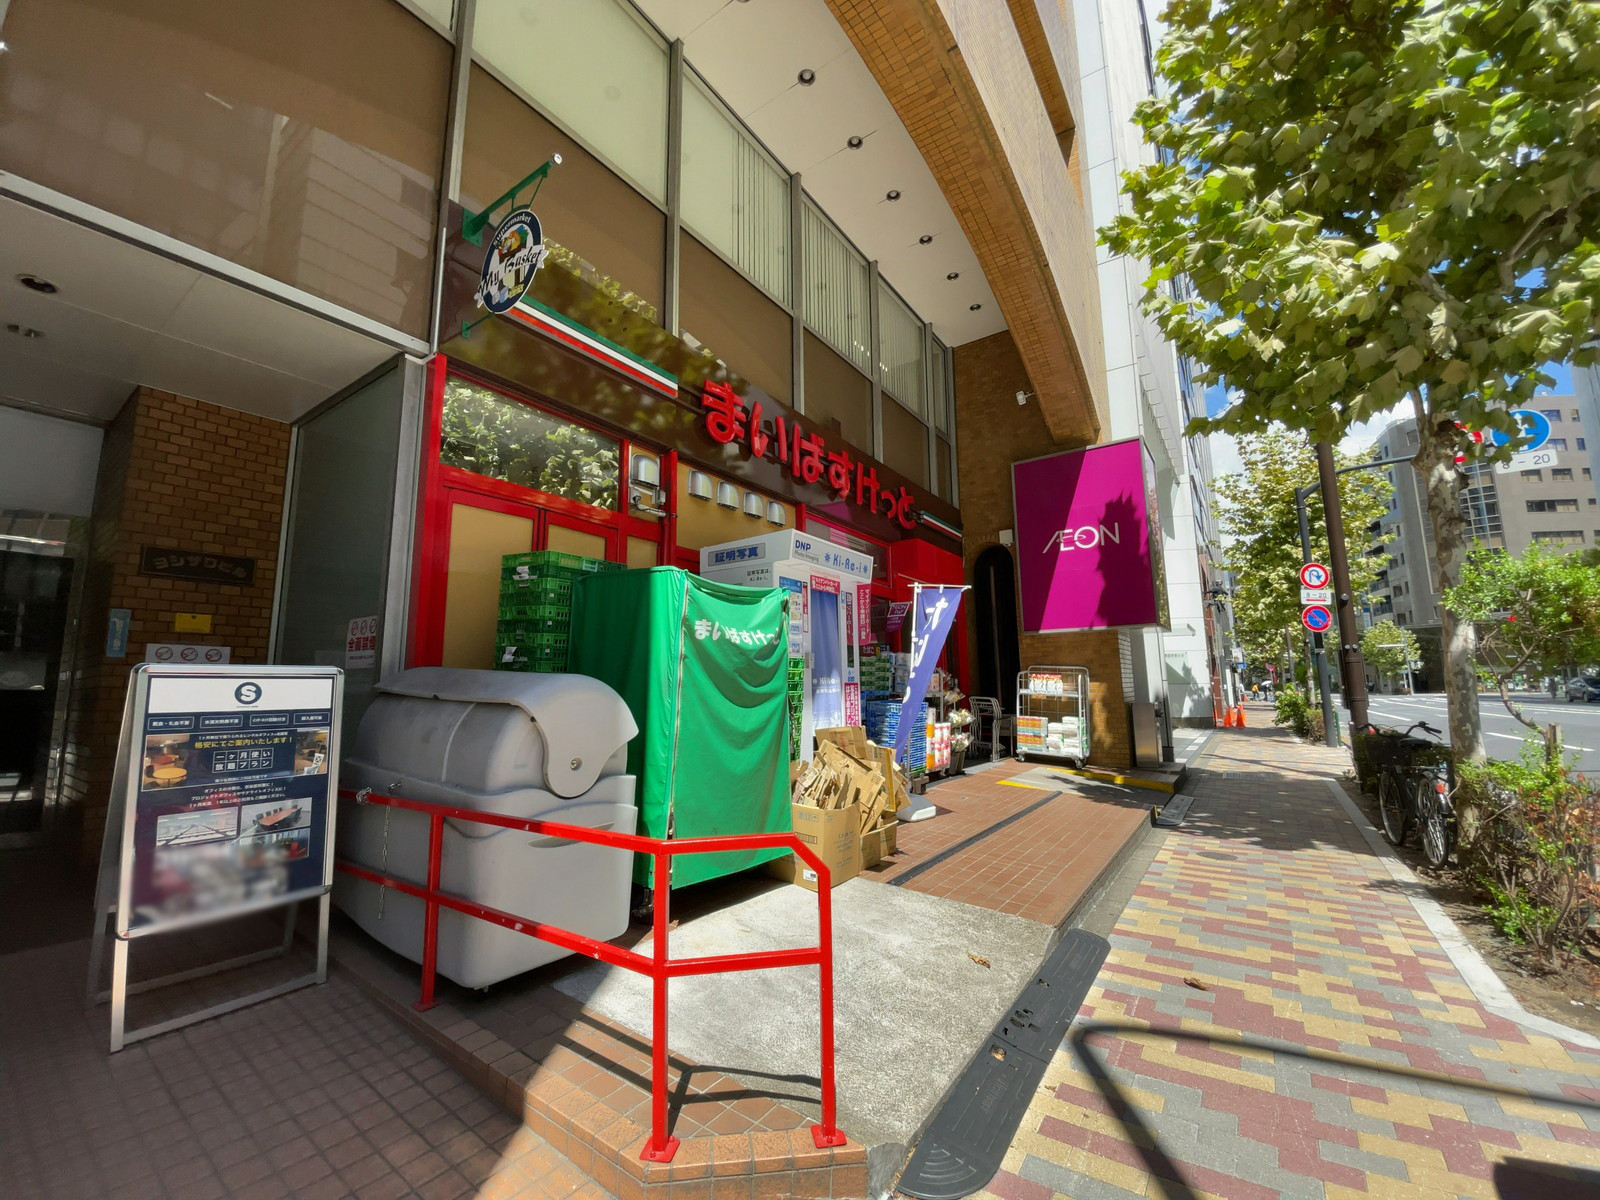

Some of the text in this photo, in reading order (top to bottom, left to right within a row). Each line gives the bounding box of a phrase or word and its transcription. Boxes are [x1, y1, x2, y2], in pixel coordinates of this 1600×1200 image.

[477, 246, 542, 297] My Basket
[701, 379, 916, 530] まいばすけっと
[795, 539, 811, 552] DNP
[715, 546, 758, 563] 証明写真
[348, 636, 377, 652] 全面禁煙
[240, 684, 256, 702] S
